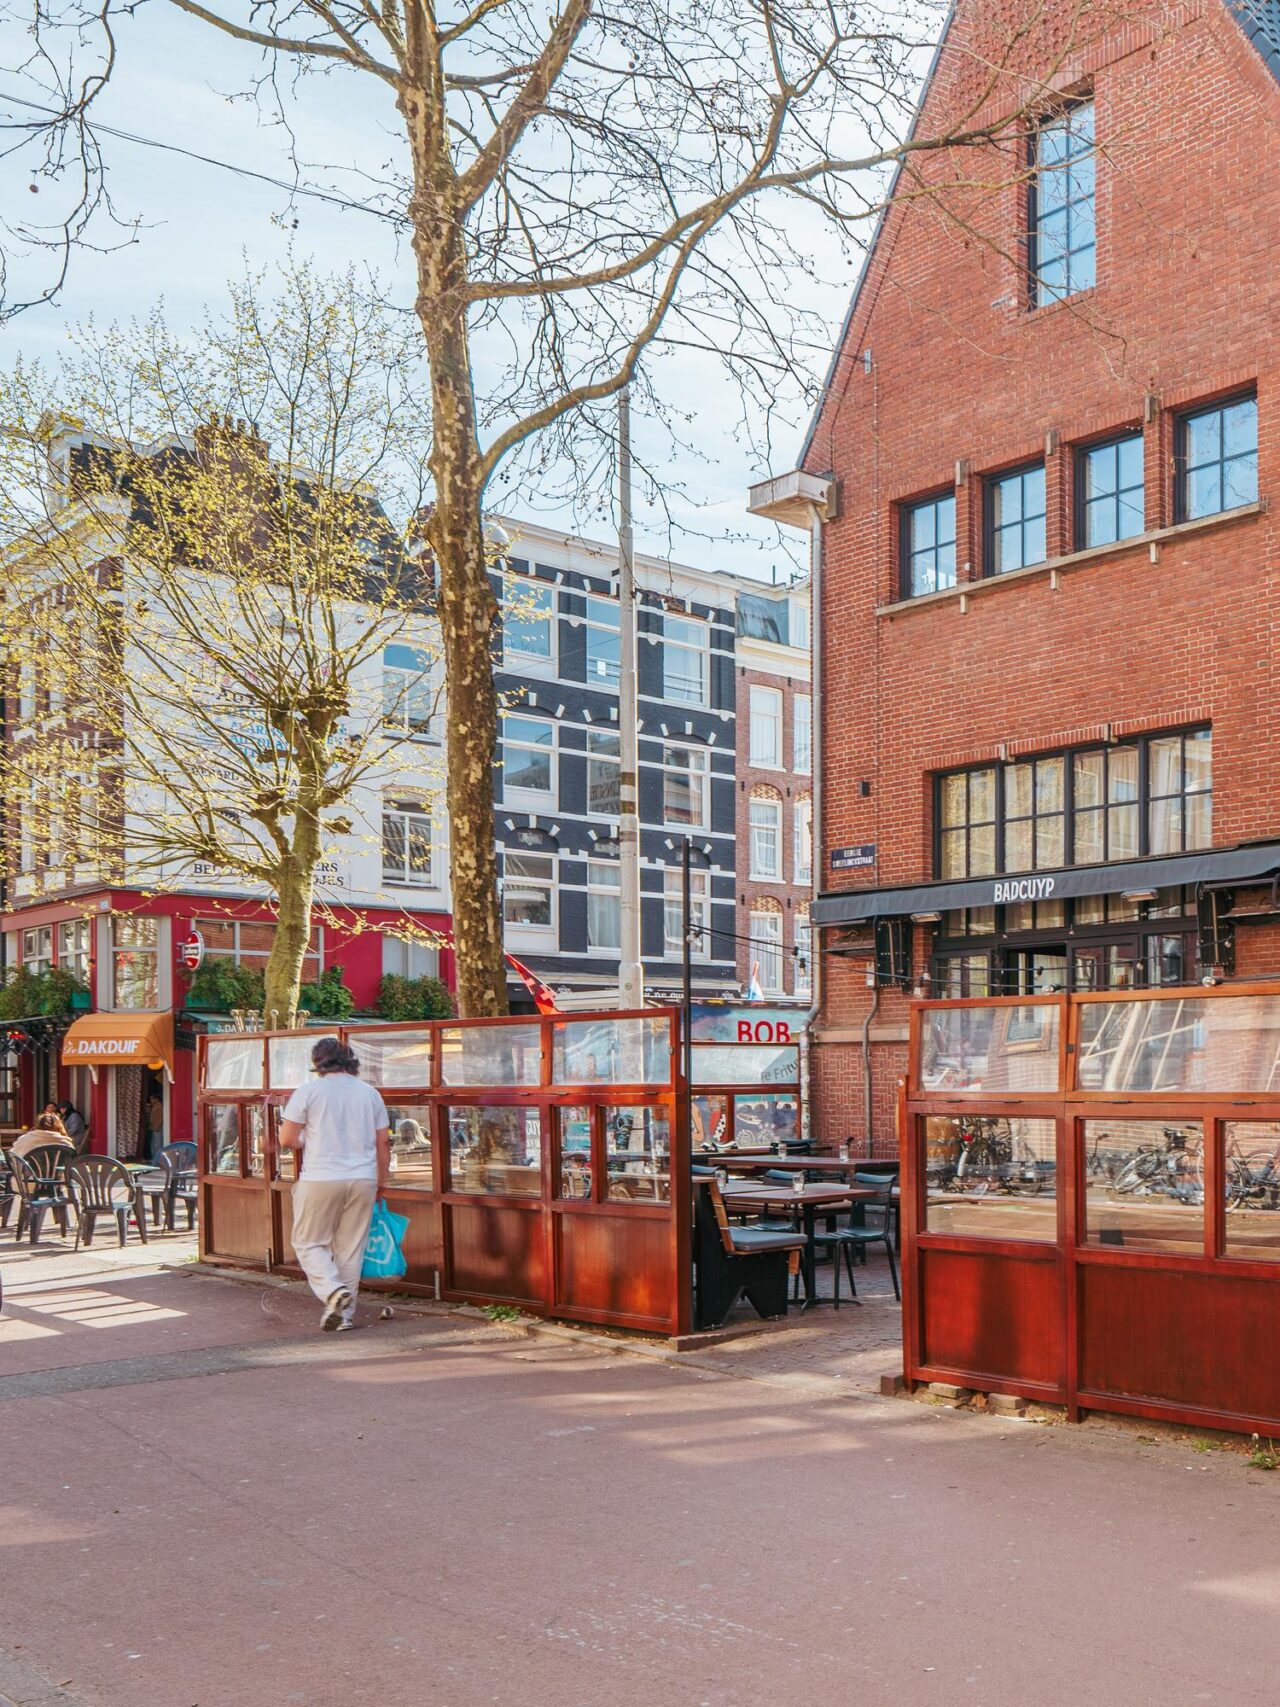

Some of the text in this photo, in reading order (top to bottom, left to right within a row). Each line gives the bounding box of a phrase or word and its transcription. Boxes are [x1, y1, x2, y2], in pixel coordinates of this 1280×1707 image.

[993, 877, 1055, 903] BADCUYP
[737, 1020, 791, 1043] BOB
[77, 1039, 140, 1055] DAKDUIF
